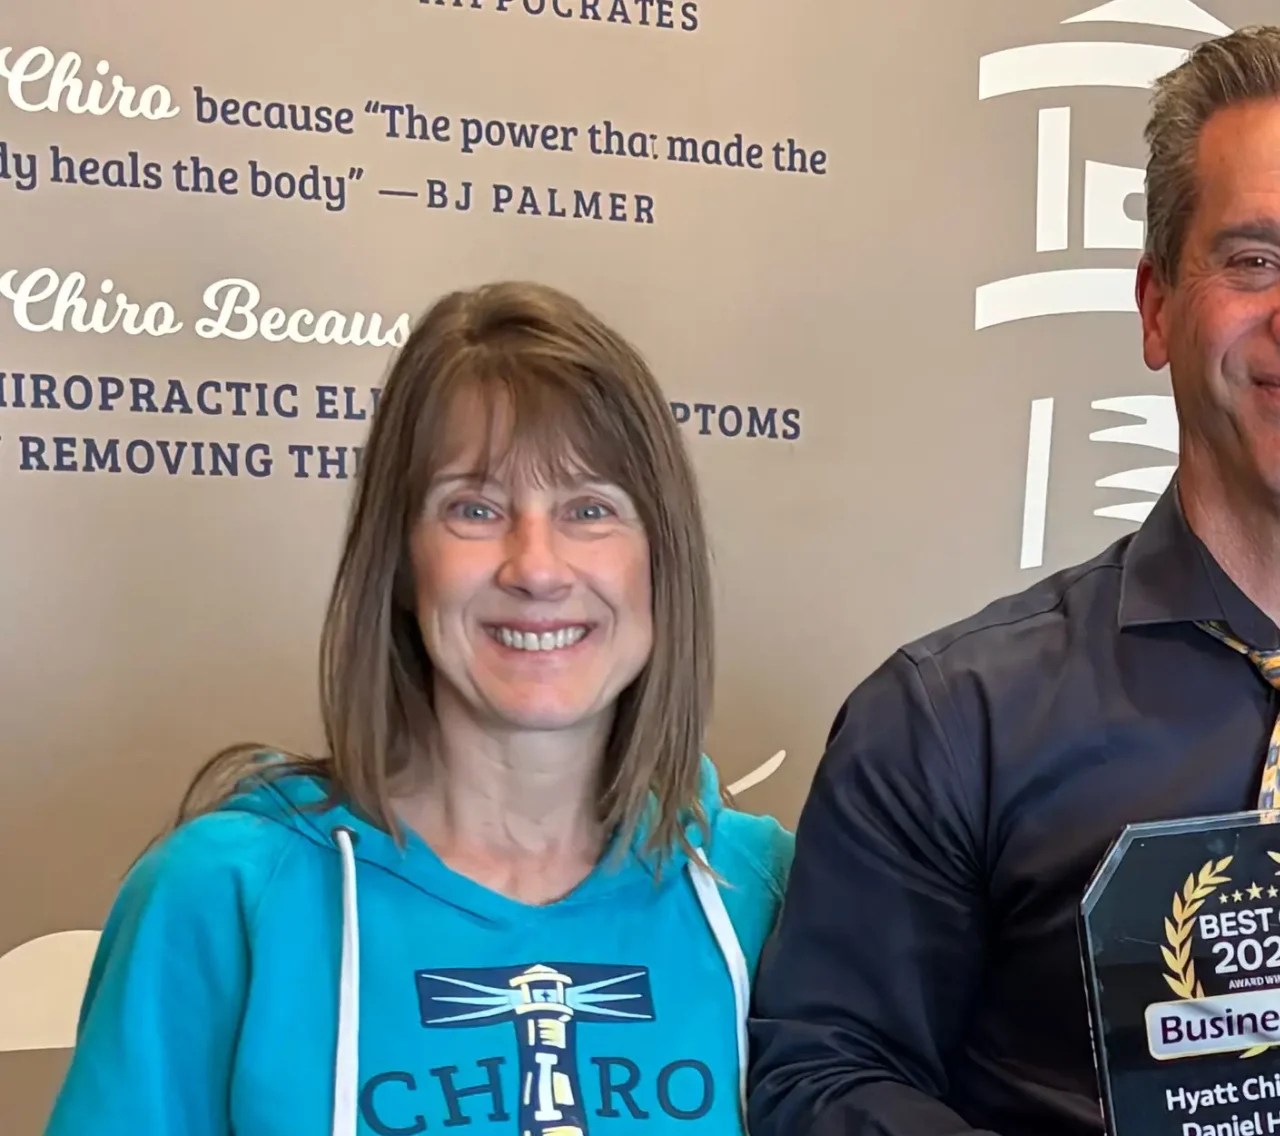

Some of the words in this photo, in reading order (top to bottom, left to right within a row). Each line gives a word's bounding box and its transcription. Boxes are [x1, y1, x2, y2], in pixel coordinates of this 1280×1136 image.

[419, 0, 699, 31] OCRATES
[0, 46, 180, 120] Chiro
[193, 86, 354, 135] because
[365, 100, 451, 142] “The
[460, 116, 578, 154] power
[667, 133, 763, 169] made
[772, 138, 827, 175] the
[50, 145, 162, 189] heals
[173, 156, 239, 195] the
[248, 160, 364, 212] body”
[492, 184, 655, 224] PALMER
[0, 267, 183, 336] Chiro
[195, 278, 411, 348] Becaus
[0, 372, 299, 419] IROPRACTIC
[669, 402, 801, 440] PTOMS
[19, 436, 273, 478] REMOVING
[1199, 907, 1273, 940] BEST
[1228, 974, 1265, 990] AWARD
[1165, 1081, 1238, 1114] Hyatt
